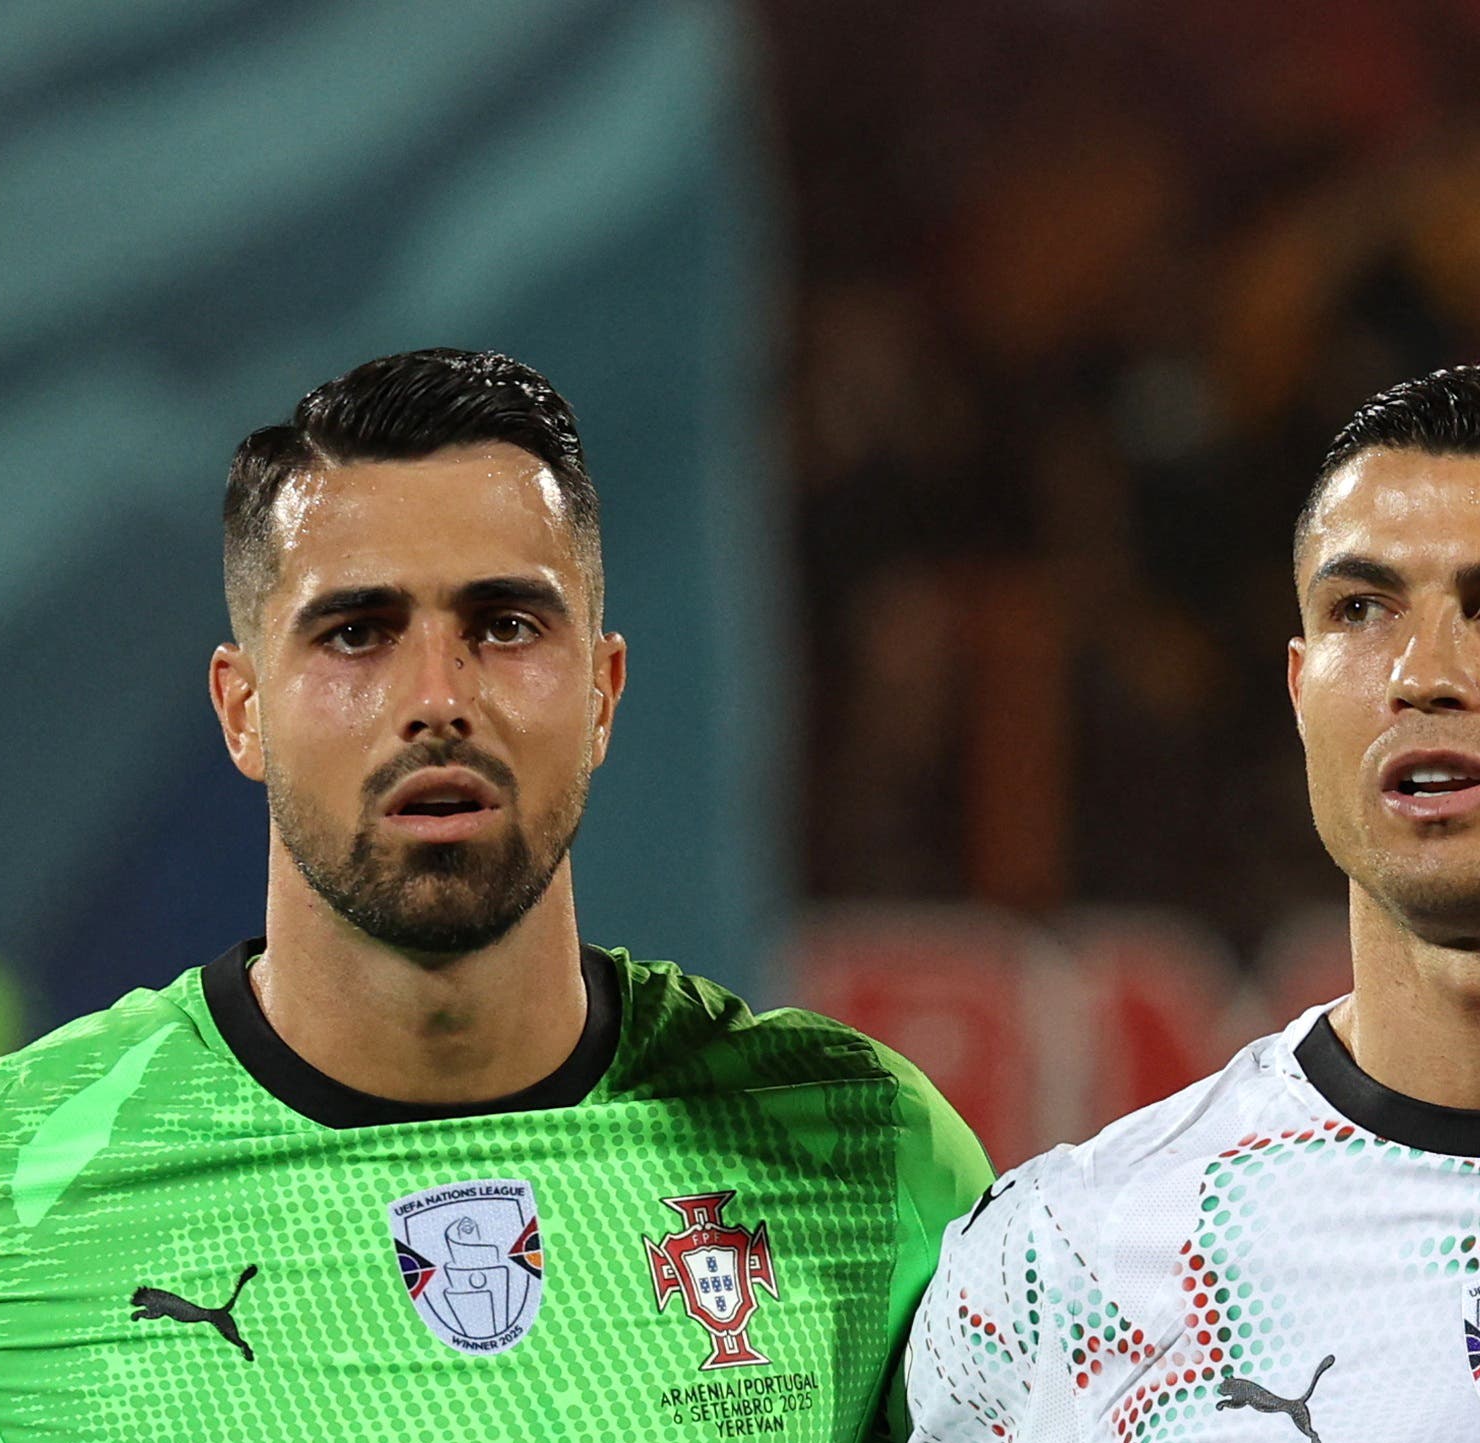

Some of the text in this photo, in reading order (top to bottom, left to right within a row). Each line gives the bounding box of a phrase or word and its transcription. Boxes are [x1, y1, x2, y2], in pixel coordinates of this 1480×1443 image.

[394, 1186, 525, 1216] UEFA NATIONS LEAGUE
[452, 1325, 523, 1351] WINNER 2025
[673, 1392, 813, 1424] 6 SETEMBRO 2025
[715, 1415, 784, 1438] YEREVAN
